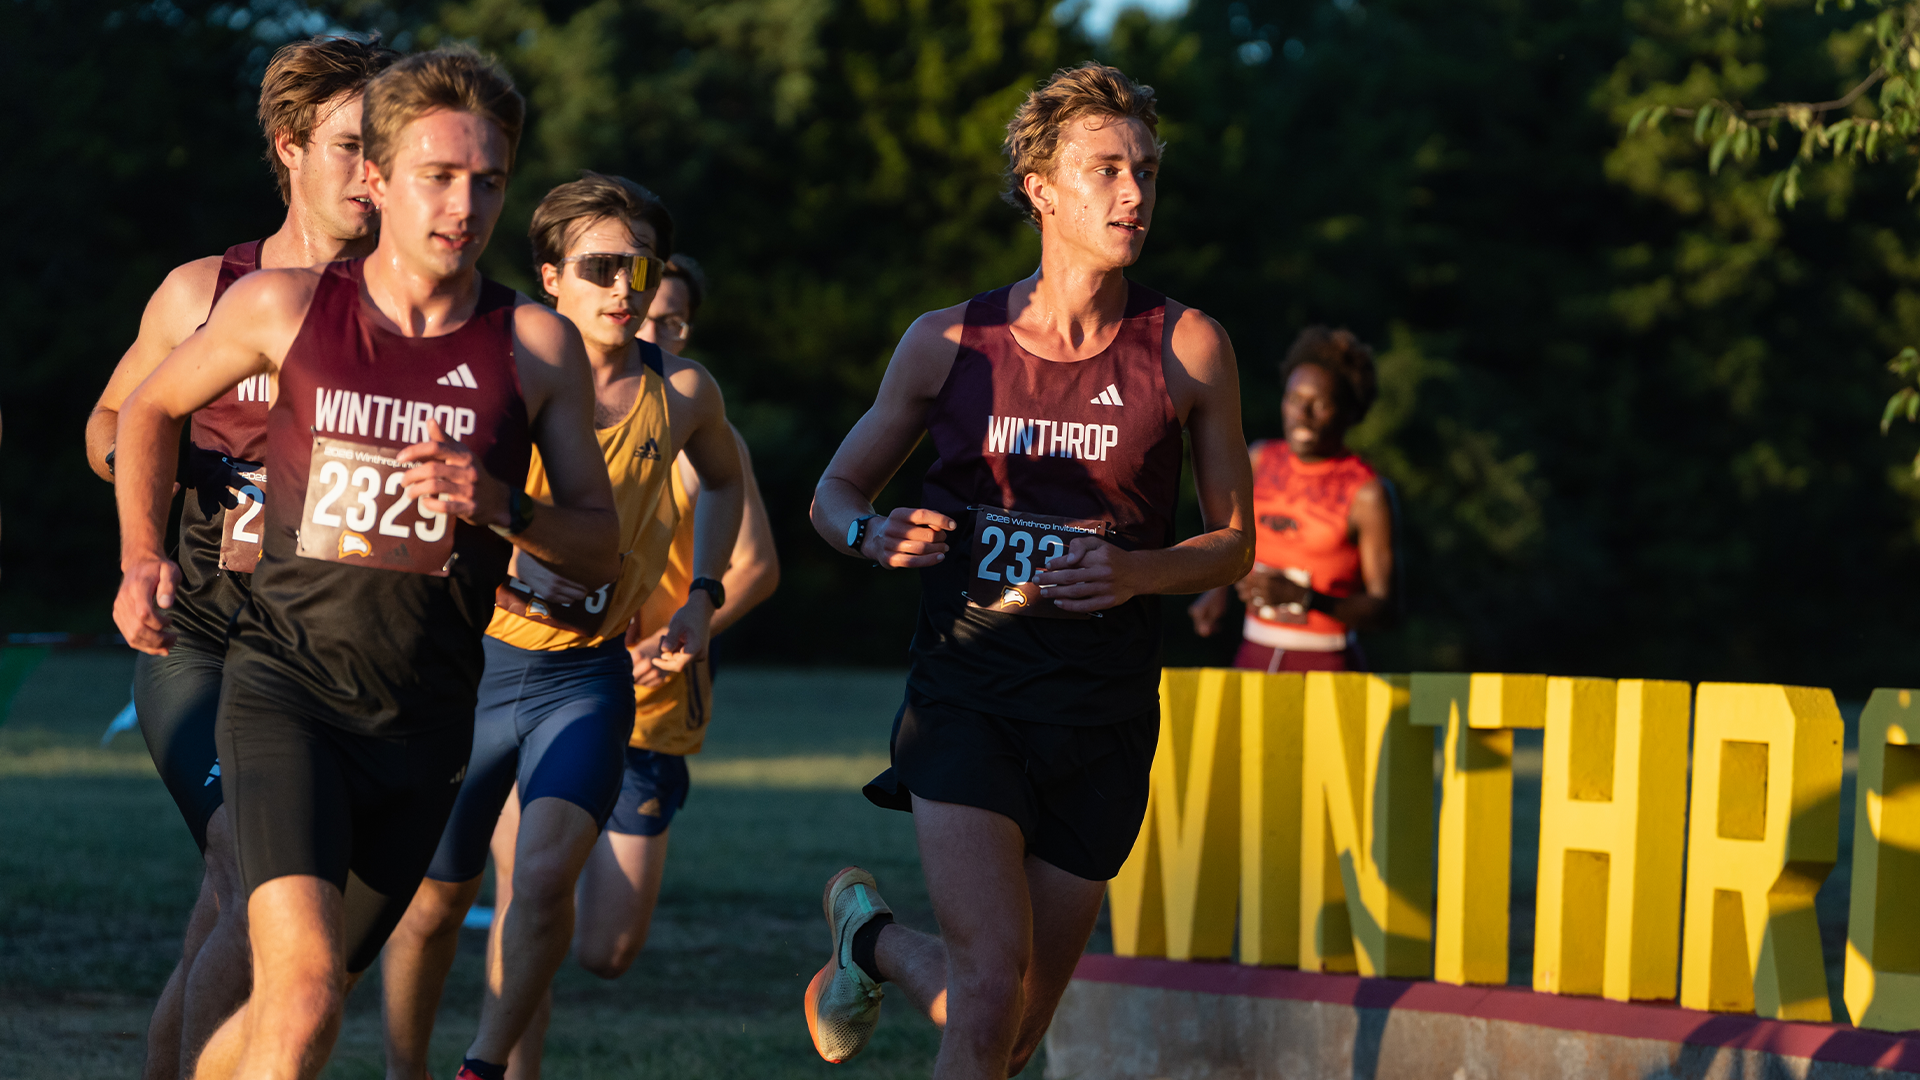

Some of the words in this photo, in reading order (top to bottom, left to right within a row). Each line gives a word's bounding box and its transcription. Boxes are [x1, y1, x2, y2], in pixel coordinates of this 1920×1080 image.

[315, 387, 476, 444] WINTHROP
[988, 415, 1118, 461] WINTHROP
[312, 460, 448, 543] 2329
[986, 513, 1010, 524] 2026
[1011, 518, 1051, 531] Winthrop
[1052, 523, 1097, 534] Invitational
[977, 526, 1085, 588] 233
